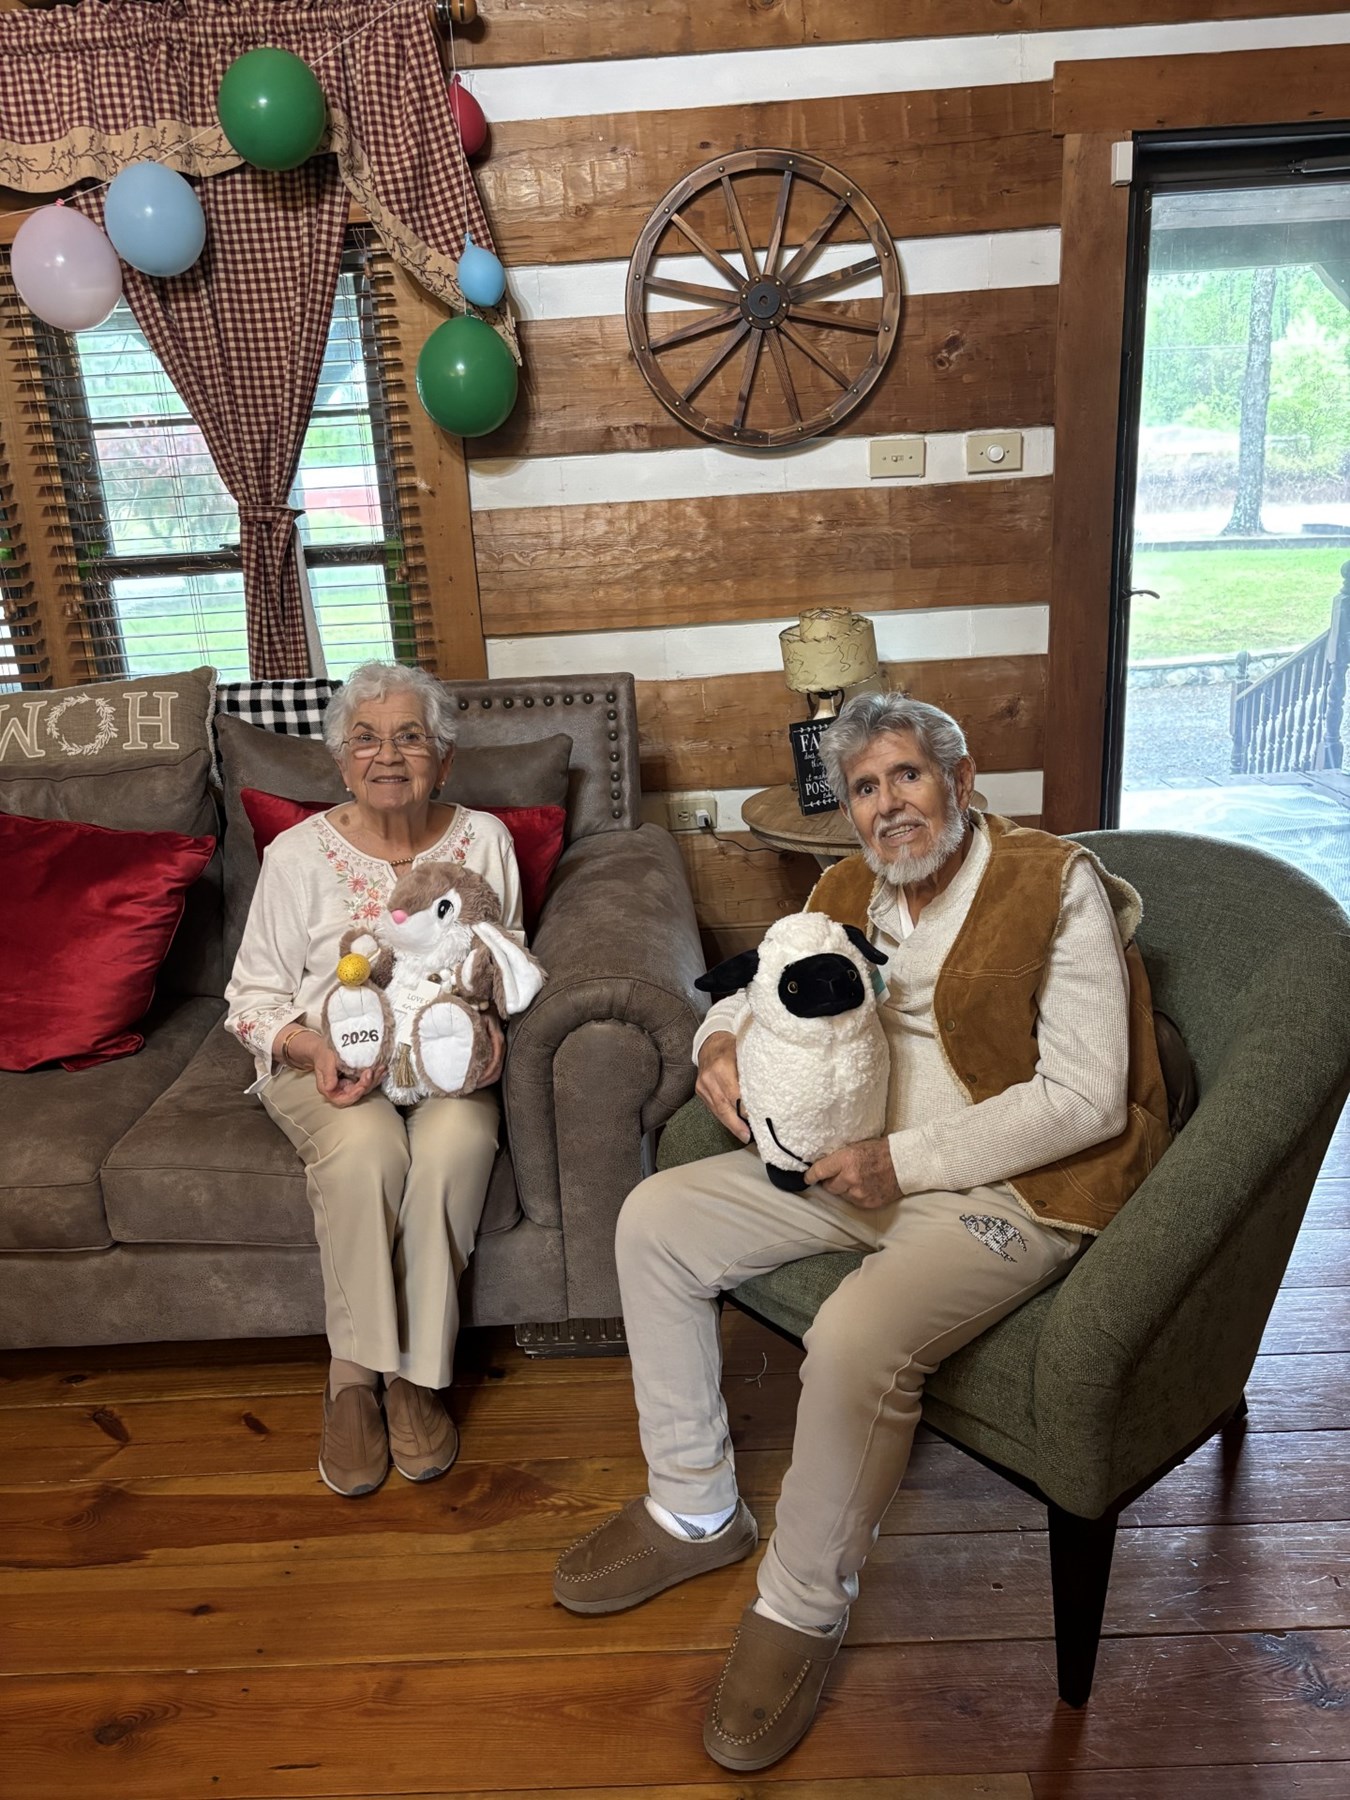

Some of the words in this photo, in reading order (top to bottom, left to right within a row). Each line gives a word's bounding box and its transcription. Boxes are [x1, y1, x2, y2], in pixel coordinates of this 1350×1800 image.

[800, 731, 823, 752] FA
[805, 780, 833, 796] POSS
[341, 1029, 379, 1048] 2026
